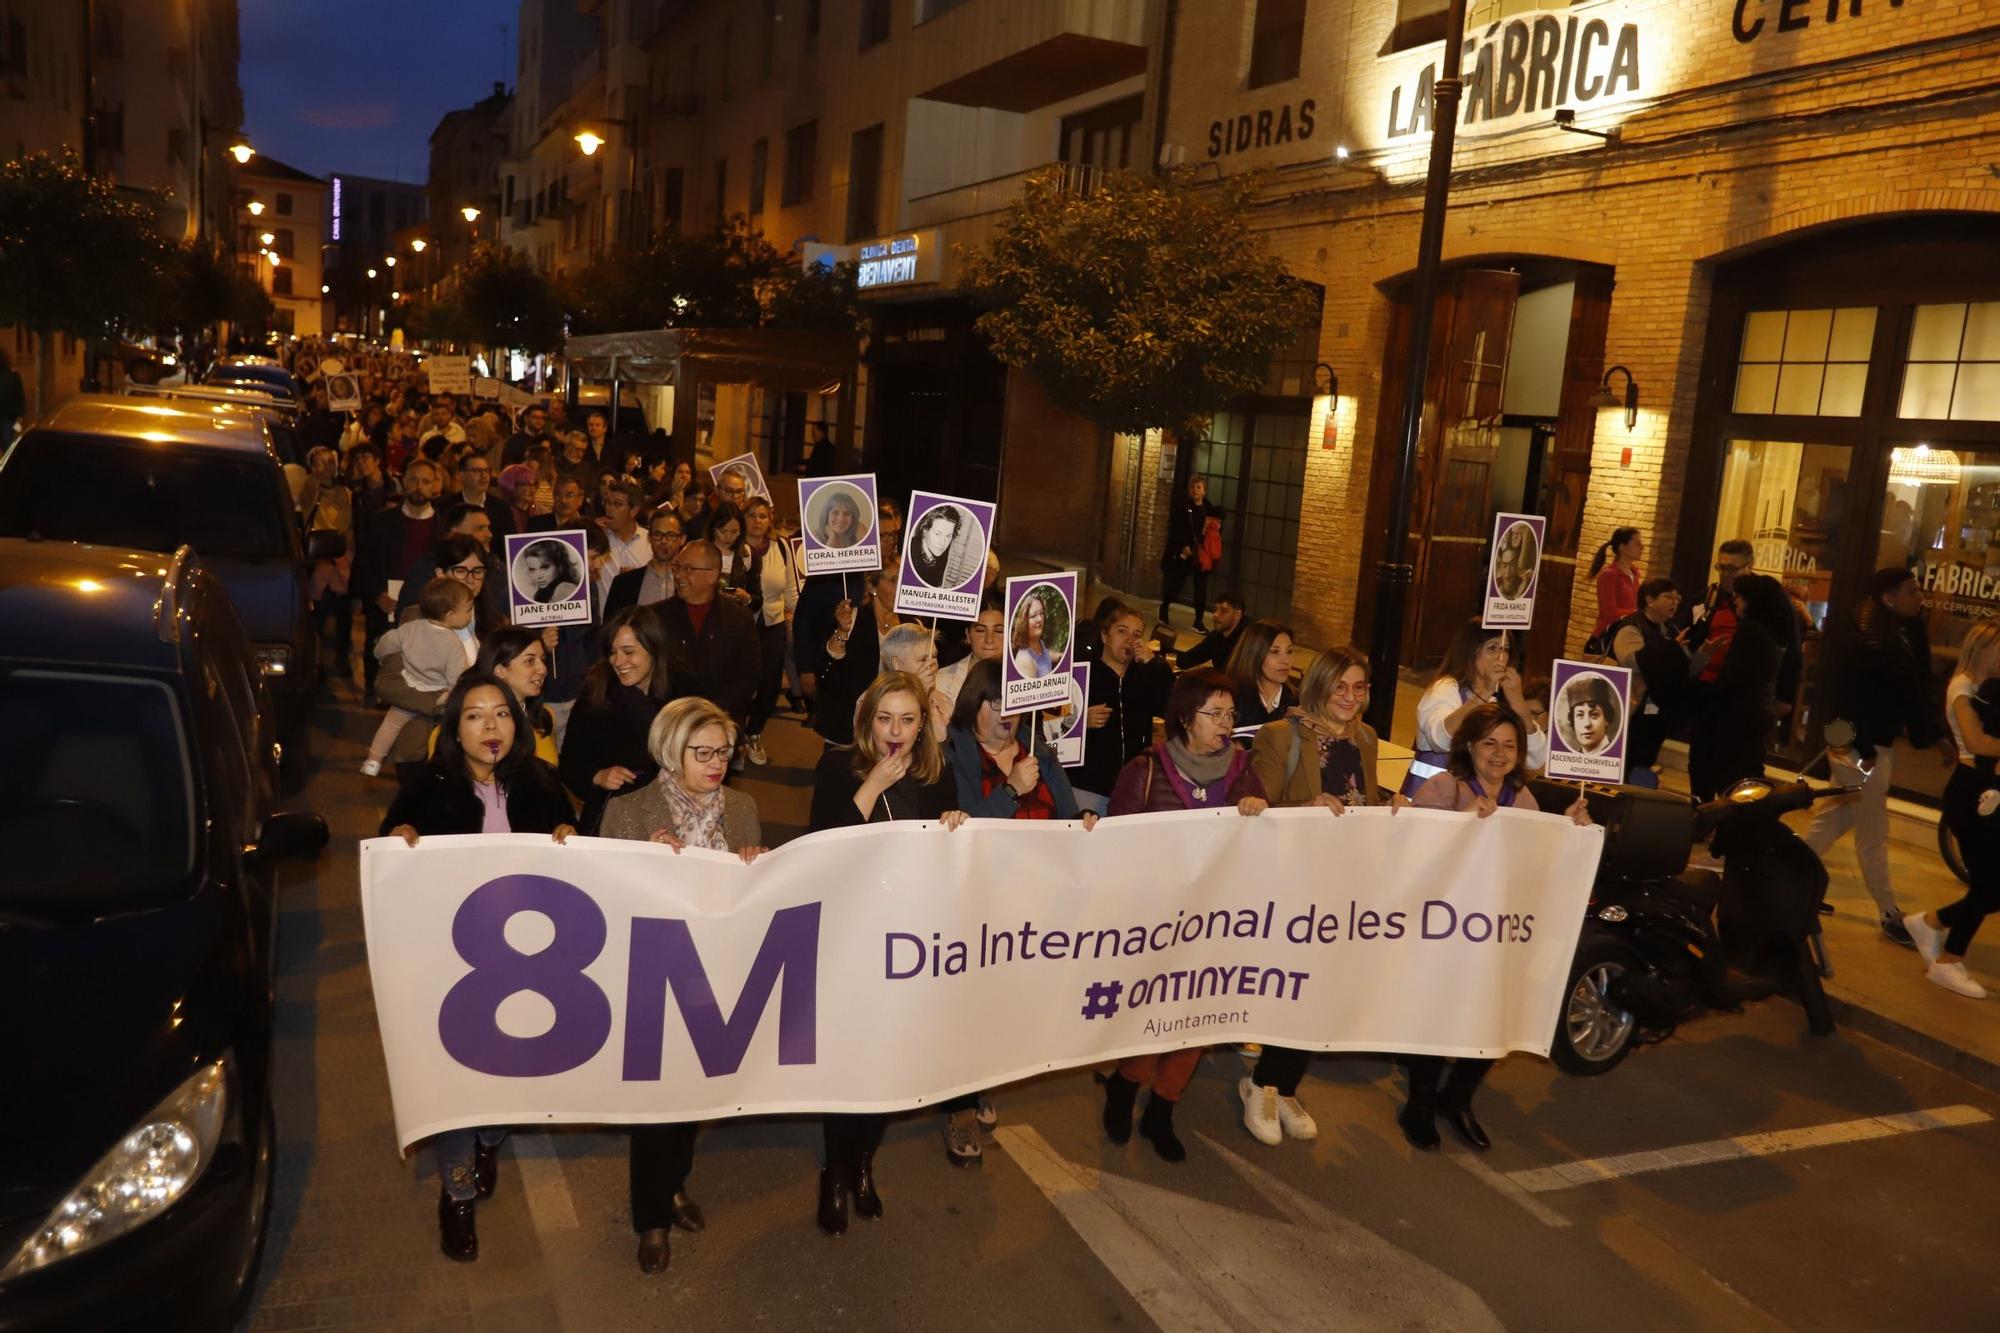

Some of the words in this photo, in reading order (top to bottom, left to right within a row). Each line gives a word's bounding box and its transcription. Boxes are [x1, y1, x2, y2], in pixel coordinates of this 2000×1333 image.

[1388, 62, 1435, 139] LA
[1208, 99, 1316, 158] SIDRAS
[858, 256, 917, 287] BENAVENT
[808, 551, 836, 560] CORAL
[838, 548, 876, 558] HERRERA
[1923, 561, 2000, 600] FÁBRICA
[901, 588, 937, 600] MANUELA
[938, 593, 976, 605] BALLESTER
[520, 605, 545, 616] JANE
[546, 602, 582, 612] FONDA
[1493, 602, 1508, 611] FRIDA
[1509, 603, 1527, 611] KAHLO
[1009, 680, 1042, 694] SOLEDAD
[1042, 676, 1067, 688] ARNAU
[1012, 694, 1036, 704] ACTIVISTA
[1569, 766, 1600, 775] ADVOCADA
[1583, 757, 1620, 768] CHIRIVELLA
[886, 932, 968, 980] Dia
[980, 900, 1275, 968] Internacional
[1286, 904, 1339, 943] de
[1348, 901, 1407, 940] les
[1421, 899, 1535, 943] Dones
[438, 874, 822, 1081] 8M
[1143, 1009, 1250, 1037] Ajuntament
